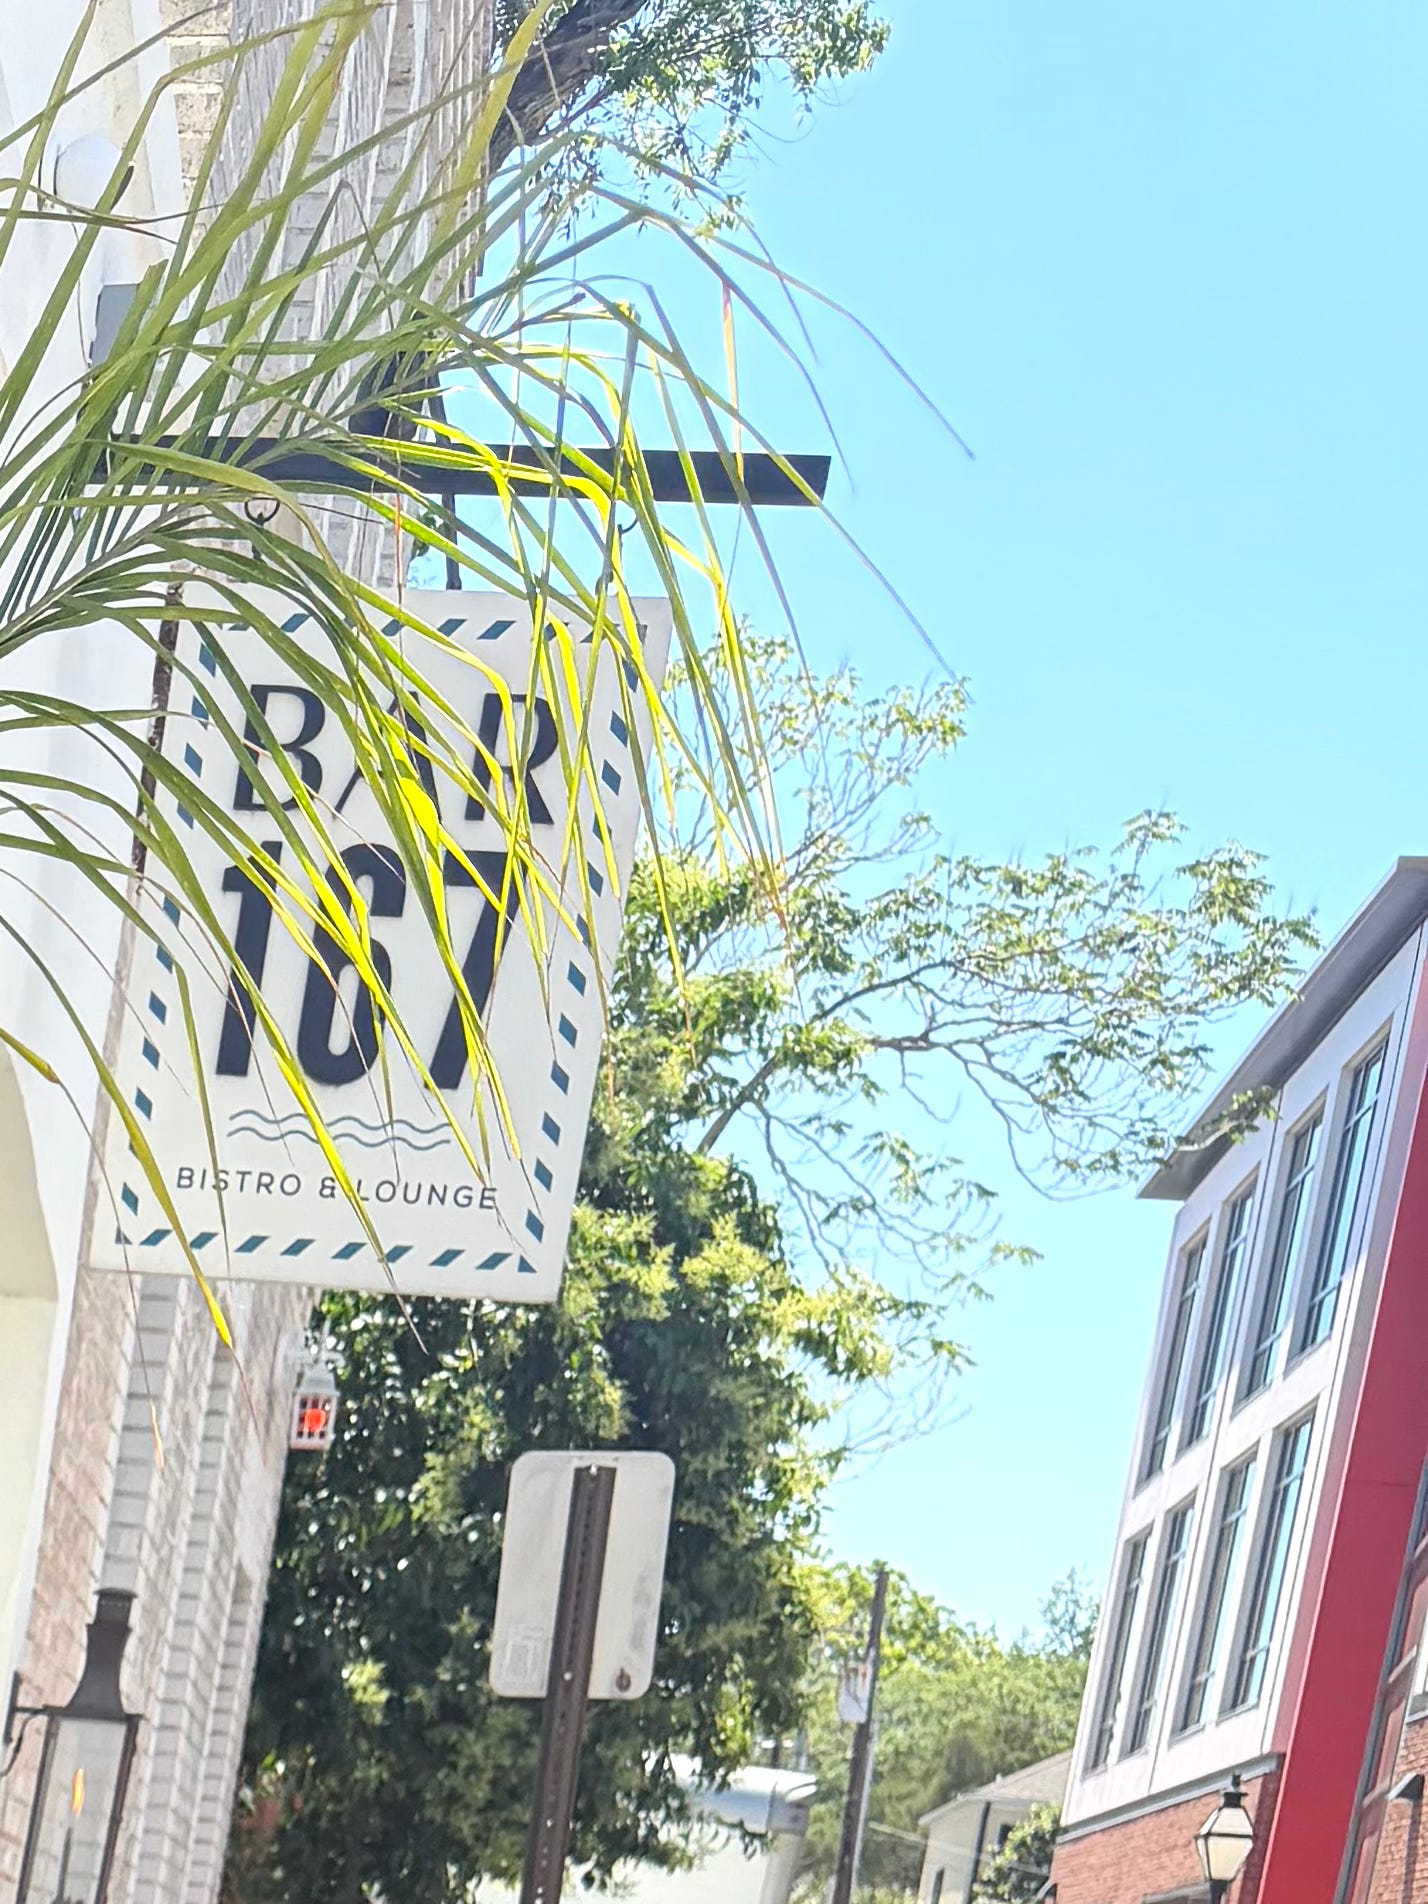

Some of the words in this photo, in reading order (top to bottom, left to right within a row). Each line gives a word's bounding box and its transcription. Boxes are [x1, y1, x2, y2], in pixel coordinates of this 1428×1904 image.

[232, 683, 560, 825] BAR
[215, 840, 530, 1090] 167
[176, 1166, 302, 1196] BISTRO
[318, 1176, 337, 1199] &
[356, 1178, 498, 1210] LOUNGE
